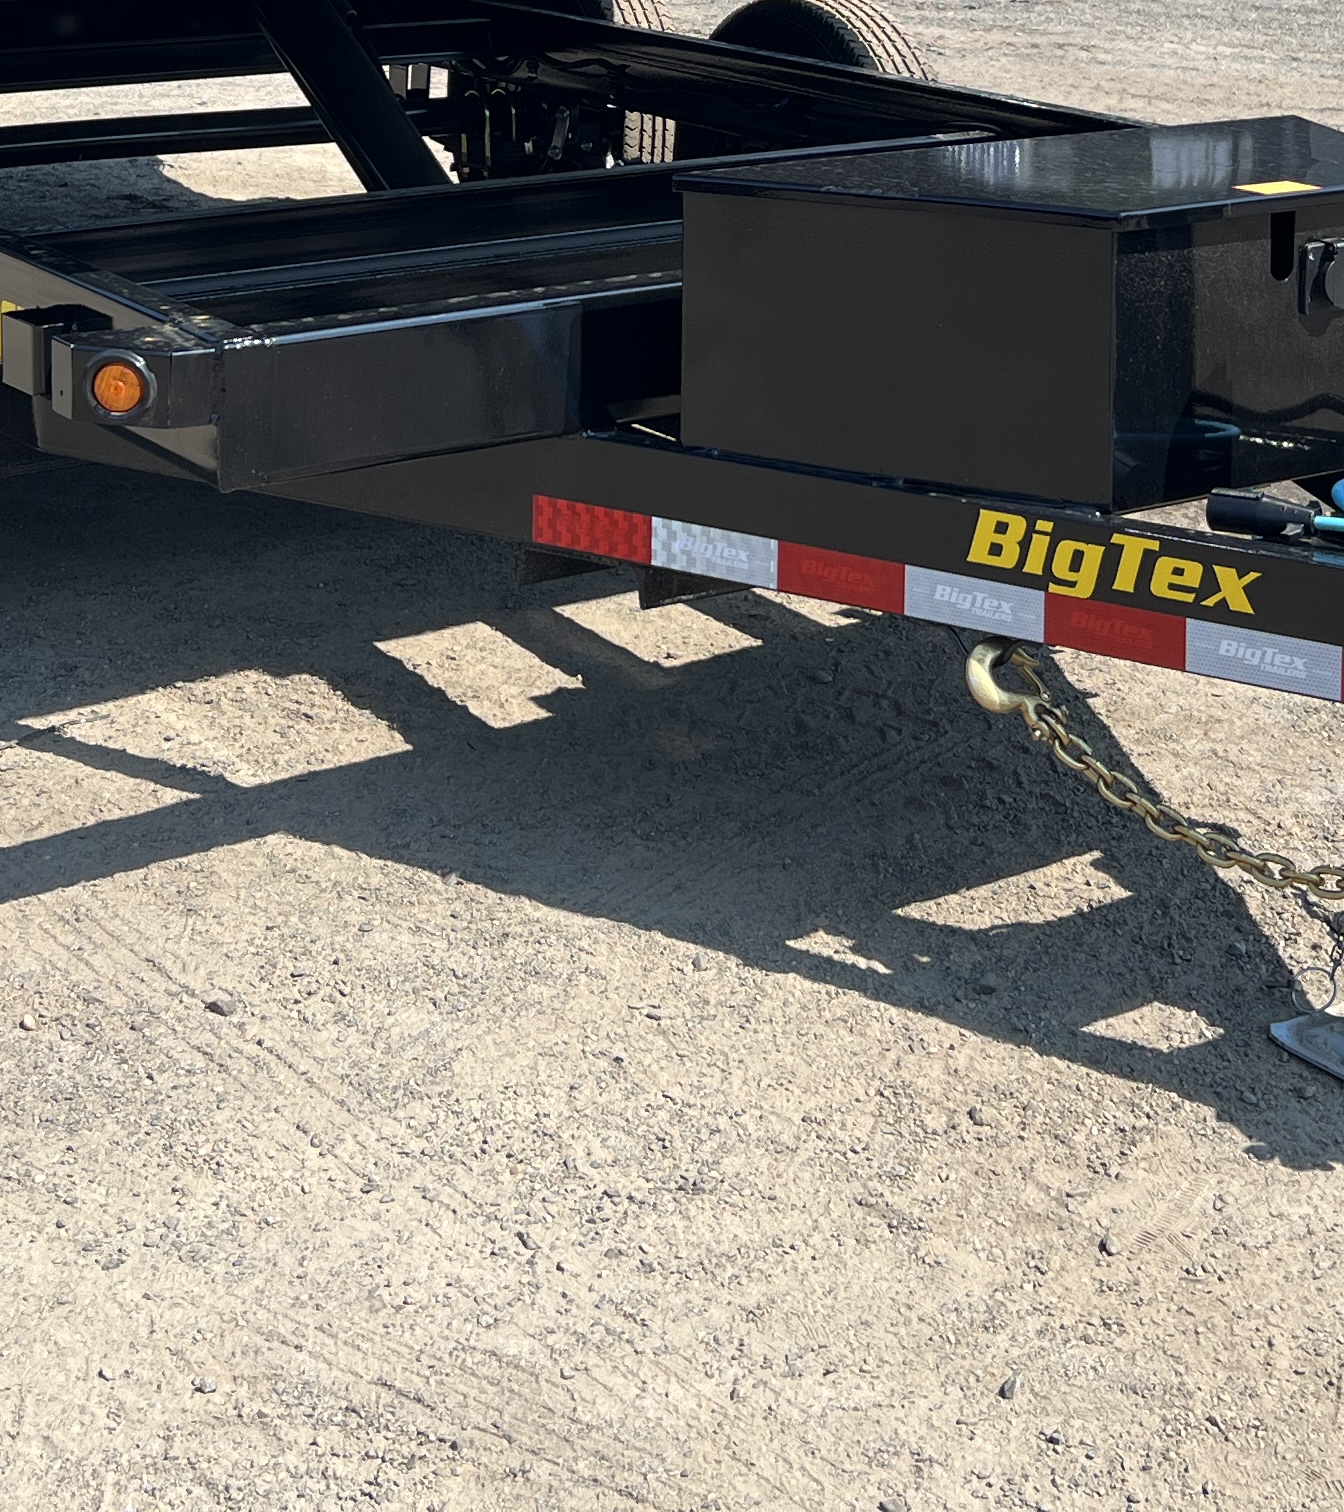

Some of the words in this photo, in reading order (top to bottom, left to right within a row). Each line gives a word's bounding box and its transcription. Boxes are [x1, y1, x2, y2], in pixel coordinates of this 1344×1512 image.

[675, 535, 751, 562] BigTex
[966, 508, 1263, 615] BigTex
[933, 584, 1014, 615] BigTex
[1218, 639, 1308, 670] BigTex
